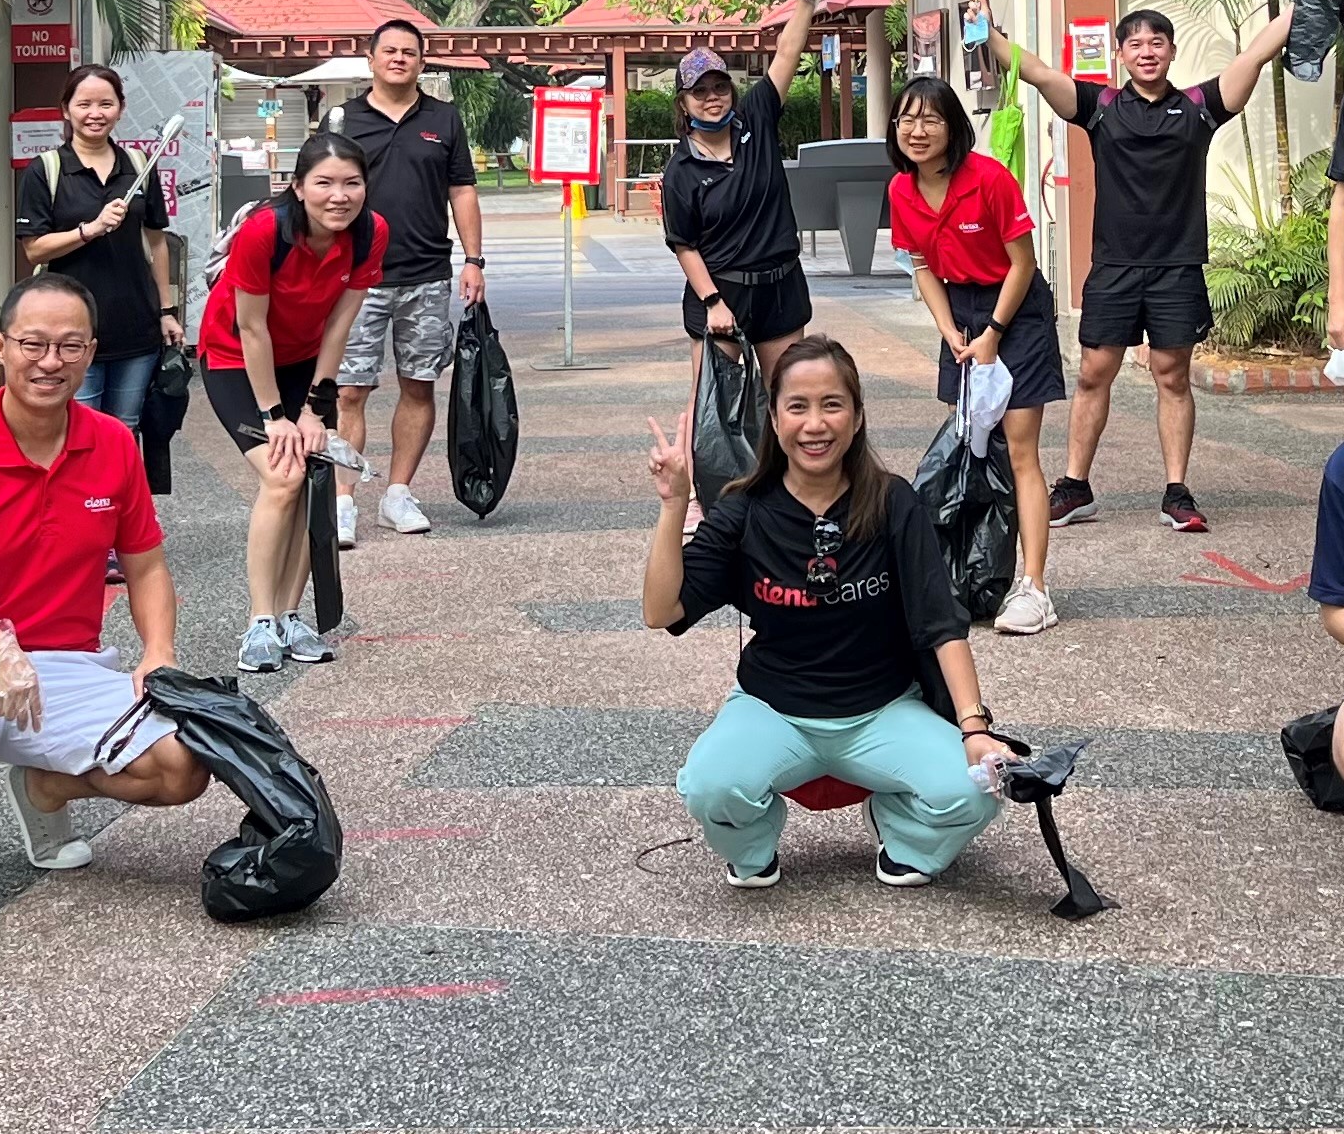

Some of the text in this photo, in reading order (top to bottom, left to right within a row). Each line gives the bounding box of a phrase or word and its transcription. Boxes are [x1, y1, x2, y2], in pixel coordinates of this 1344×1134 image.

[31, 30, 50, 42] NO
[15, 44, 66, 57] TOUTING
[551, 92, 589, 103] ENTRY
